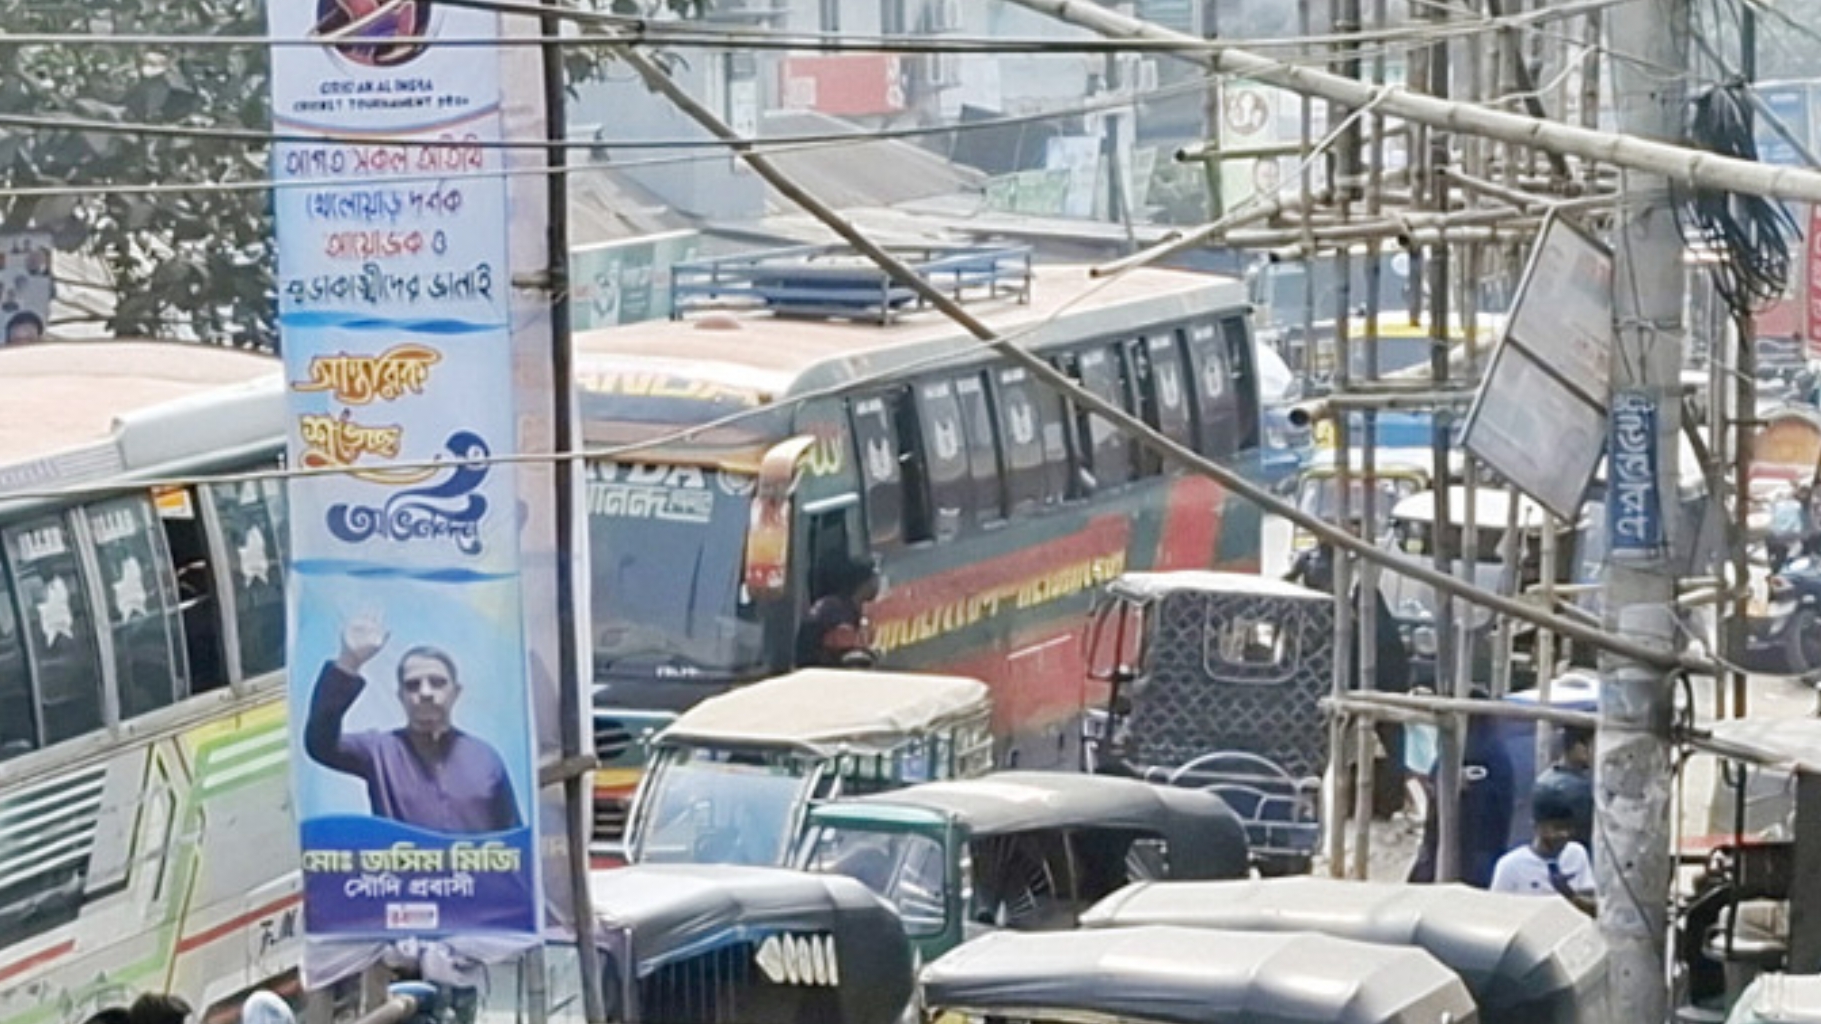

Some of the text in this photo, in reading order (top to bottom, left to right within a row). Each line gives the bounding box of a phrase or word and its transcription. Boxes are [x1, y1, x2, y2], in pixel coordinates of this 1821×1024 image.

[303, 848, 353, 872] মোঃ
[344, 871, 474, 898] সৌদি প্রবাসী
